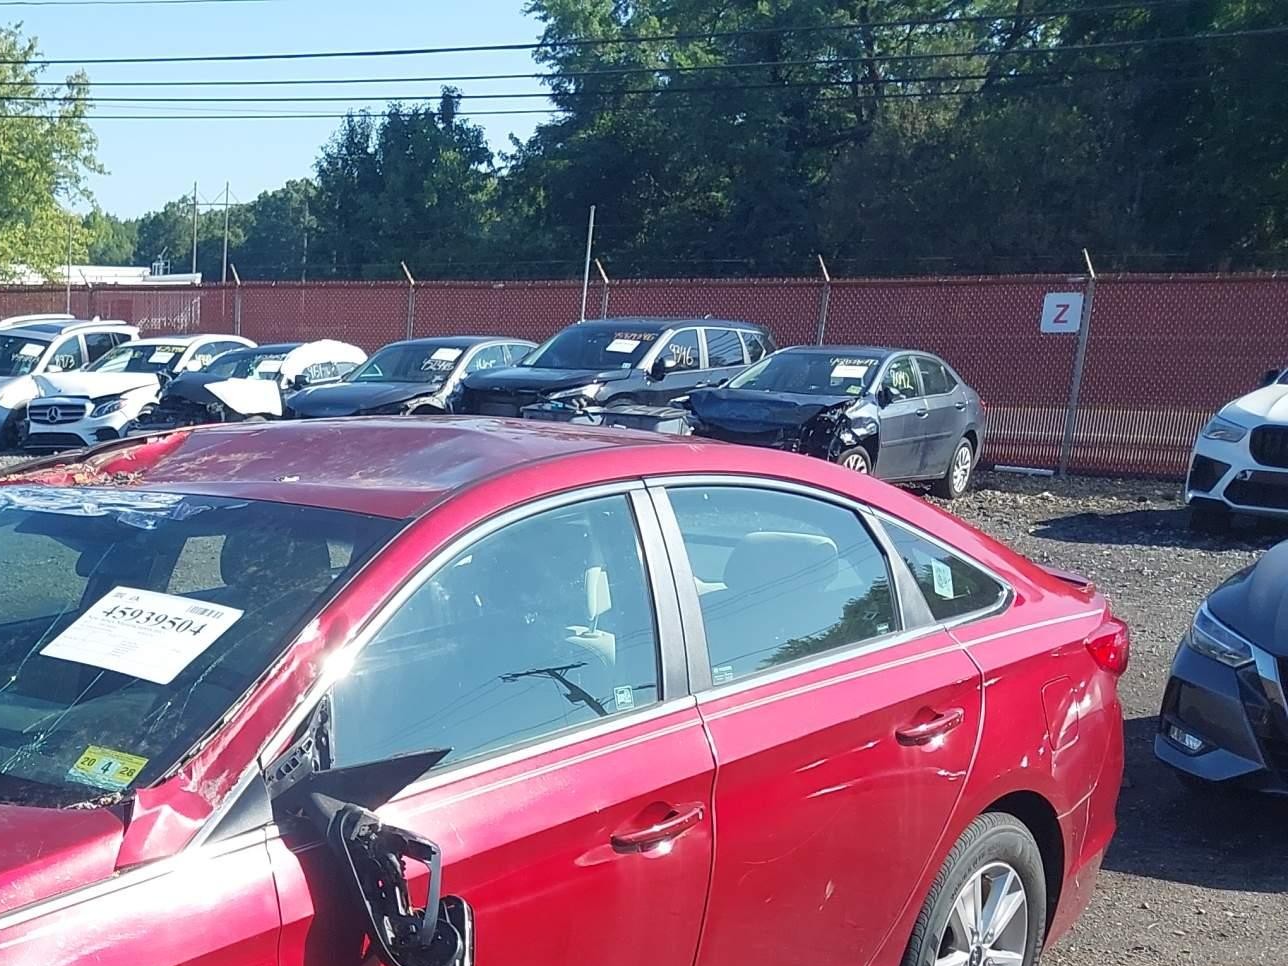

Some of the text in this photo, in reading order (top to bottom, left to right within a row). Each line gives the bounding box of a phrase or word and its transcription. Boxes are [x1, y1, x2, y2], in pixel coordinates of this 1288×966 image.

[1052, 304, 1071, 324] Z
[101, 605, 208, 637] 45939504
[80, 757, 97, 767] 20
[100, 761, 113, 774] 4
